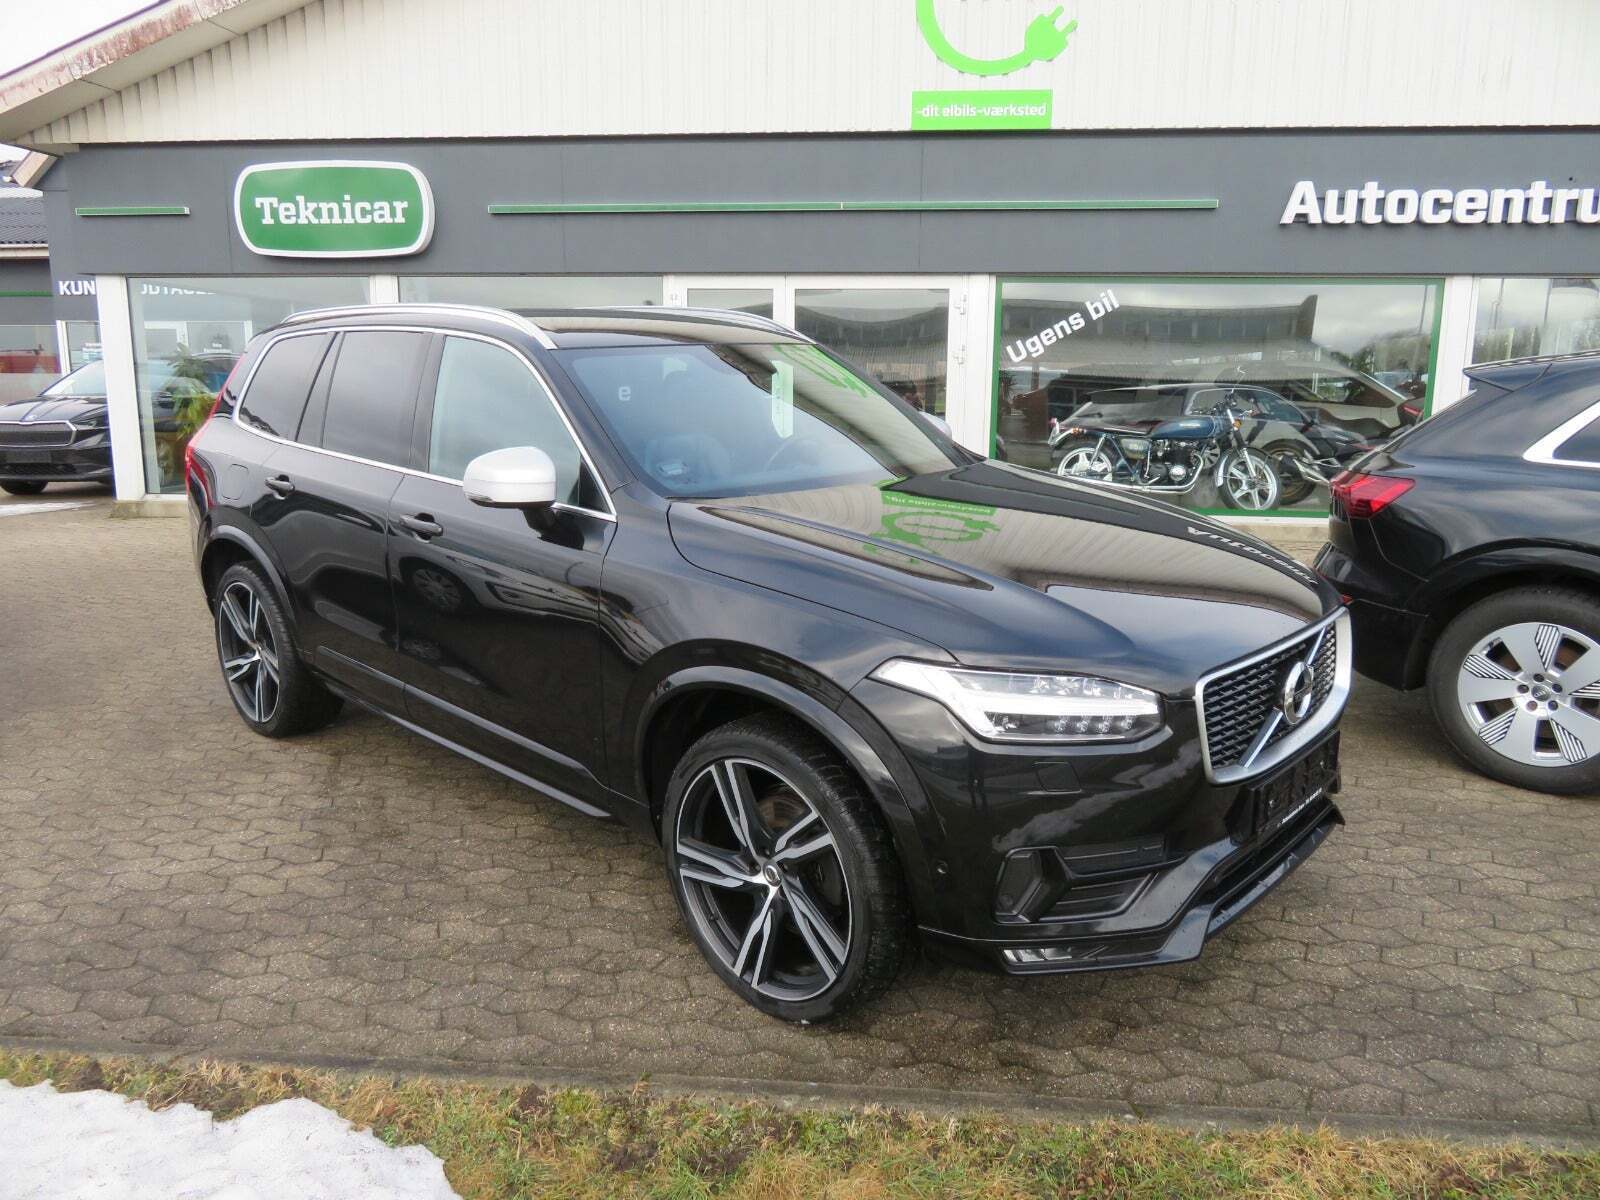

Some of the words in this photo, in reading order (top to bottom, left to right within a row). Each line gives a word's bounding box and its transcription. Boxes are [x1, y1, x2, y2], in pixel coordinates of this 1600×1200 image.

[255, 195, 408, 225] Teknicar
[1279, 180, 1600, 225] Autocentru
[1006, 312, 1085, 363] Ugens
[1085, 289, 1120, 321] bil
